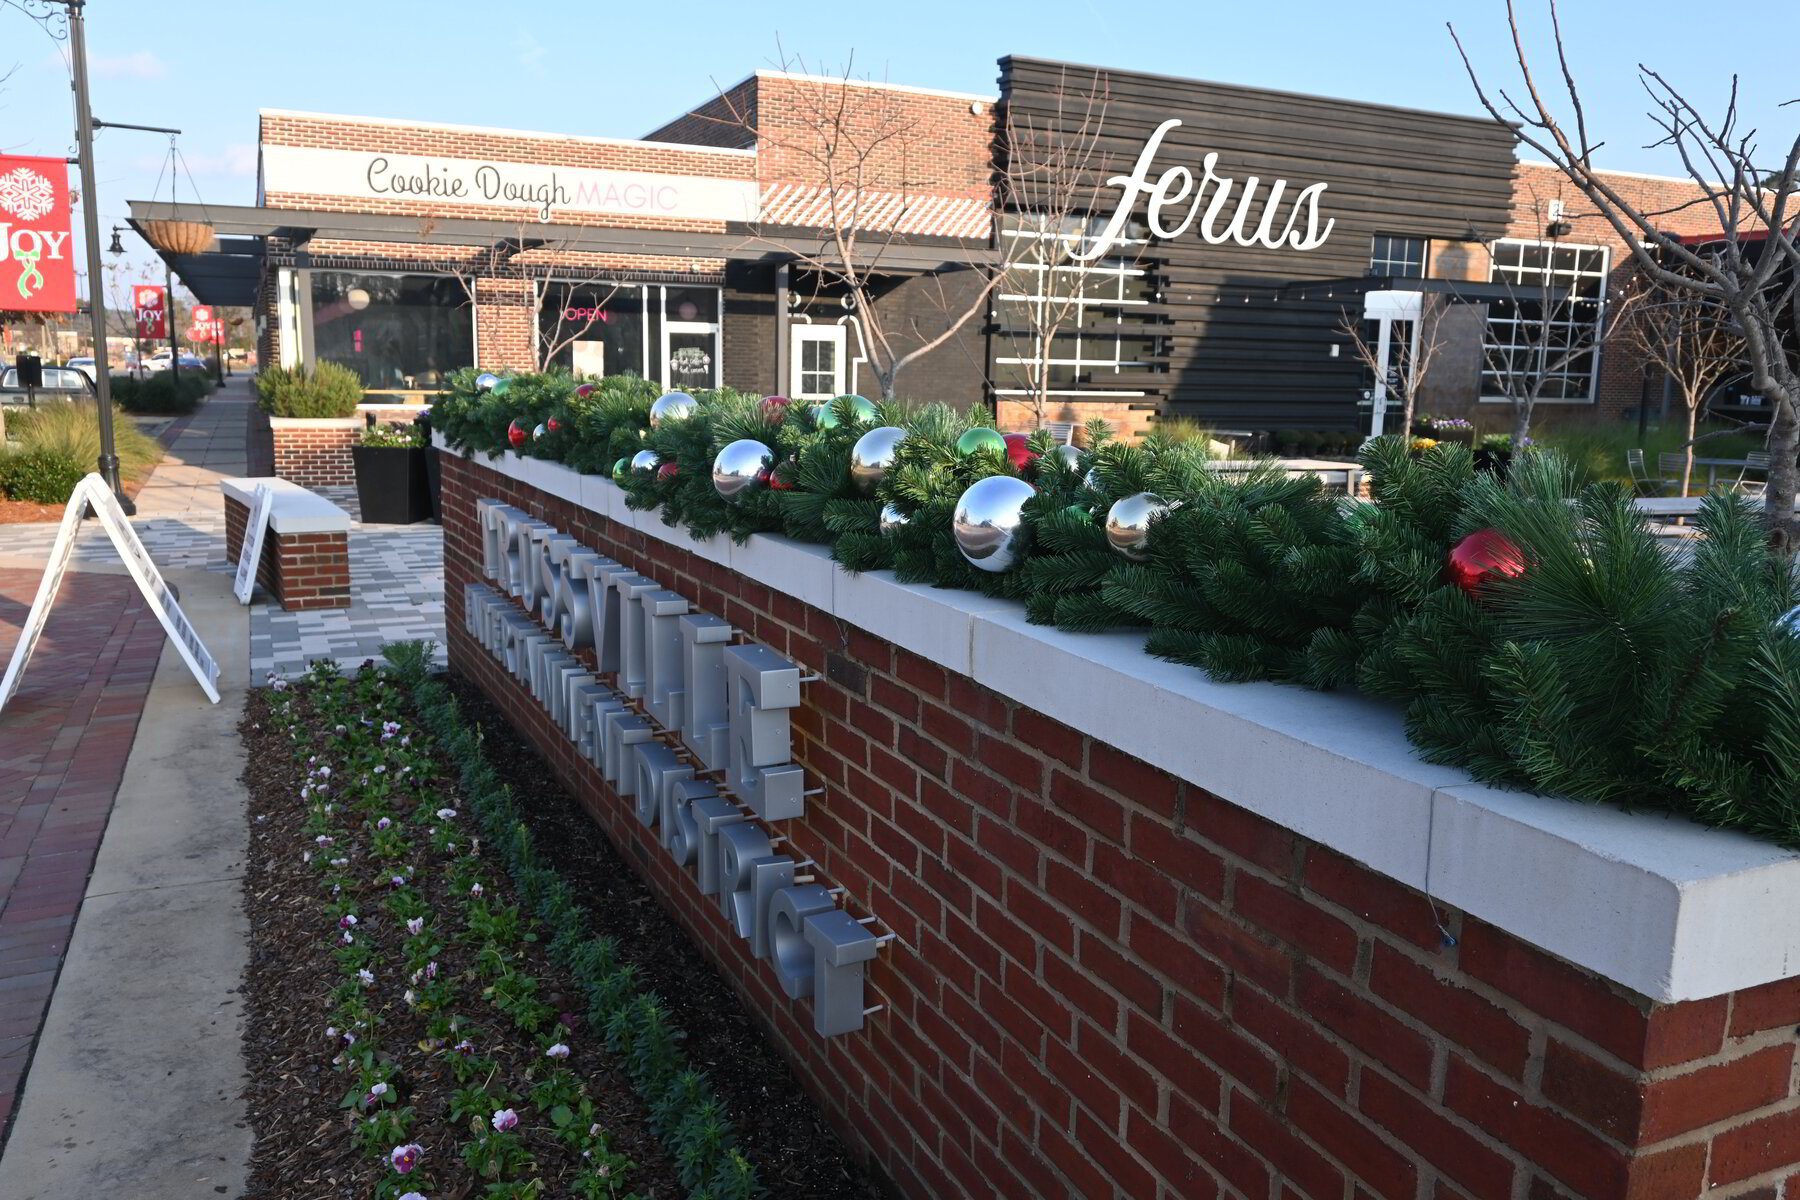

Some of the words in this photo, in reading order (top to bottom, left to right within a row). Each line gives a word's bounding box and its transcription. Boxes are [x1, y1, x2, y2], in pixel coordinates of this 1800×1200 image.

[367, 158, 468, 197] Cookie
[475, 165, 571, 220] Dough
[576, 180, 678, 211] MAGIC
[1063, 119, 1335, 260] ferus
[0, 222, 70, 262] JOY
[136, 308, 163, 322] JOY
[563, 307, 608, 324] OPEN
[477, 498, 804, 821] TRUSSVILLE
[634, 741, 877, 1038] DISTRICT
